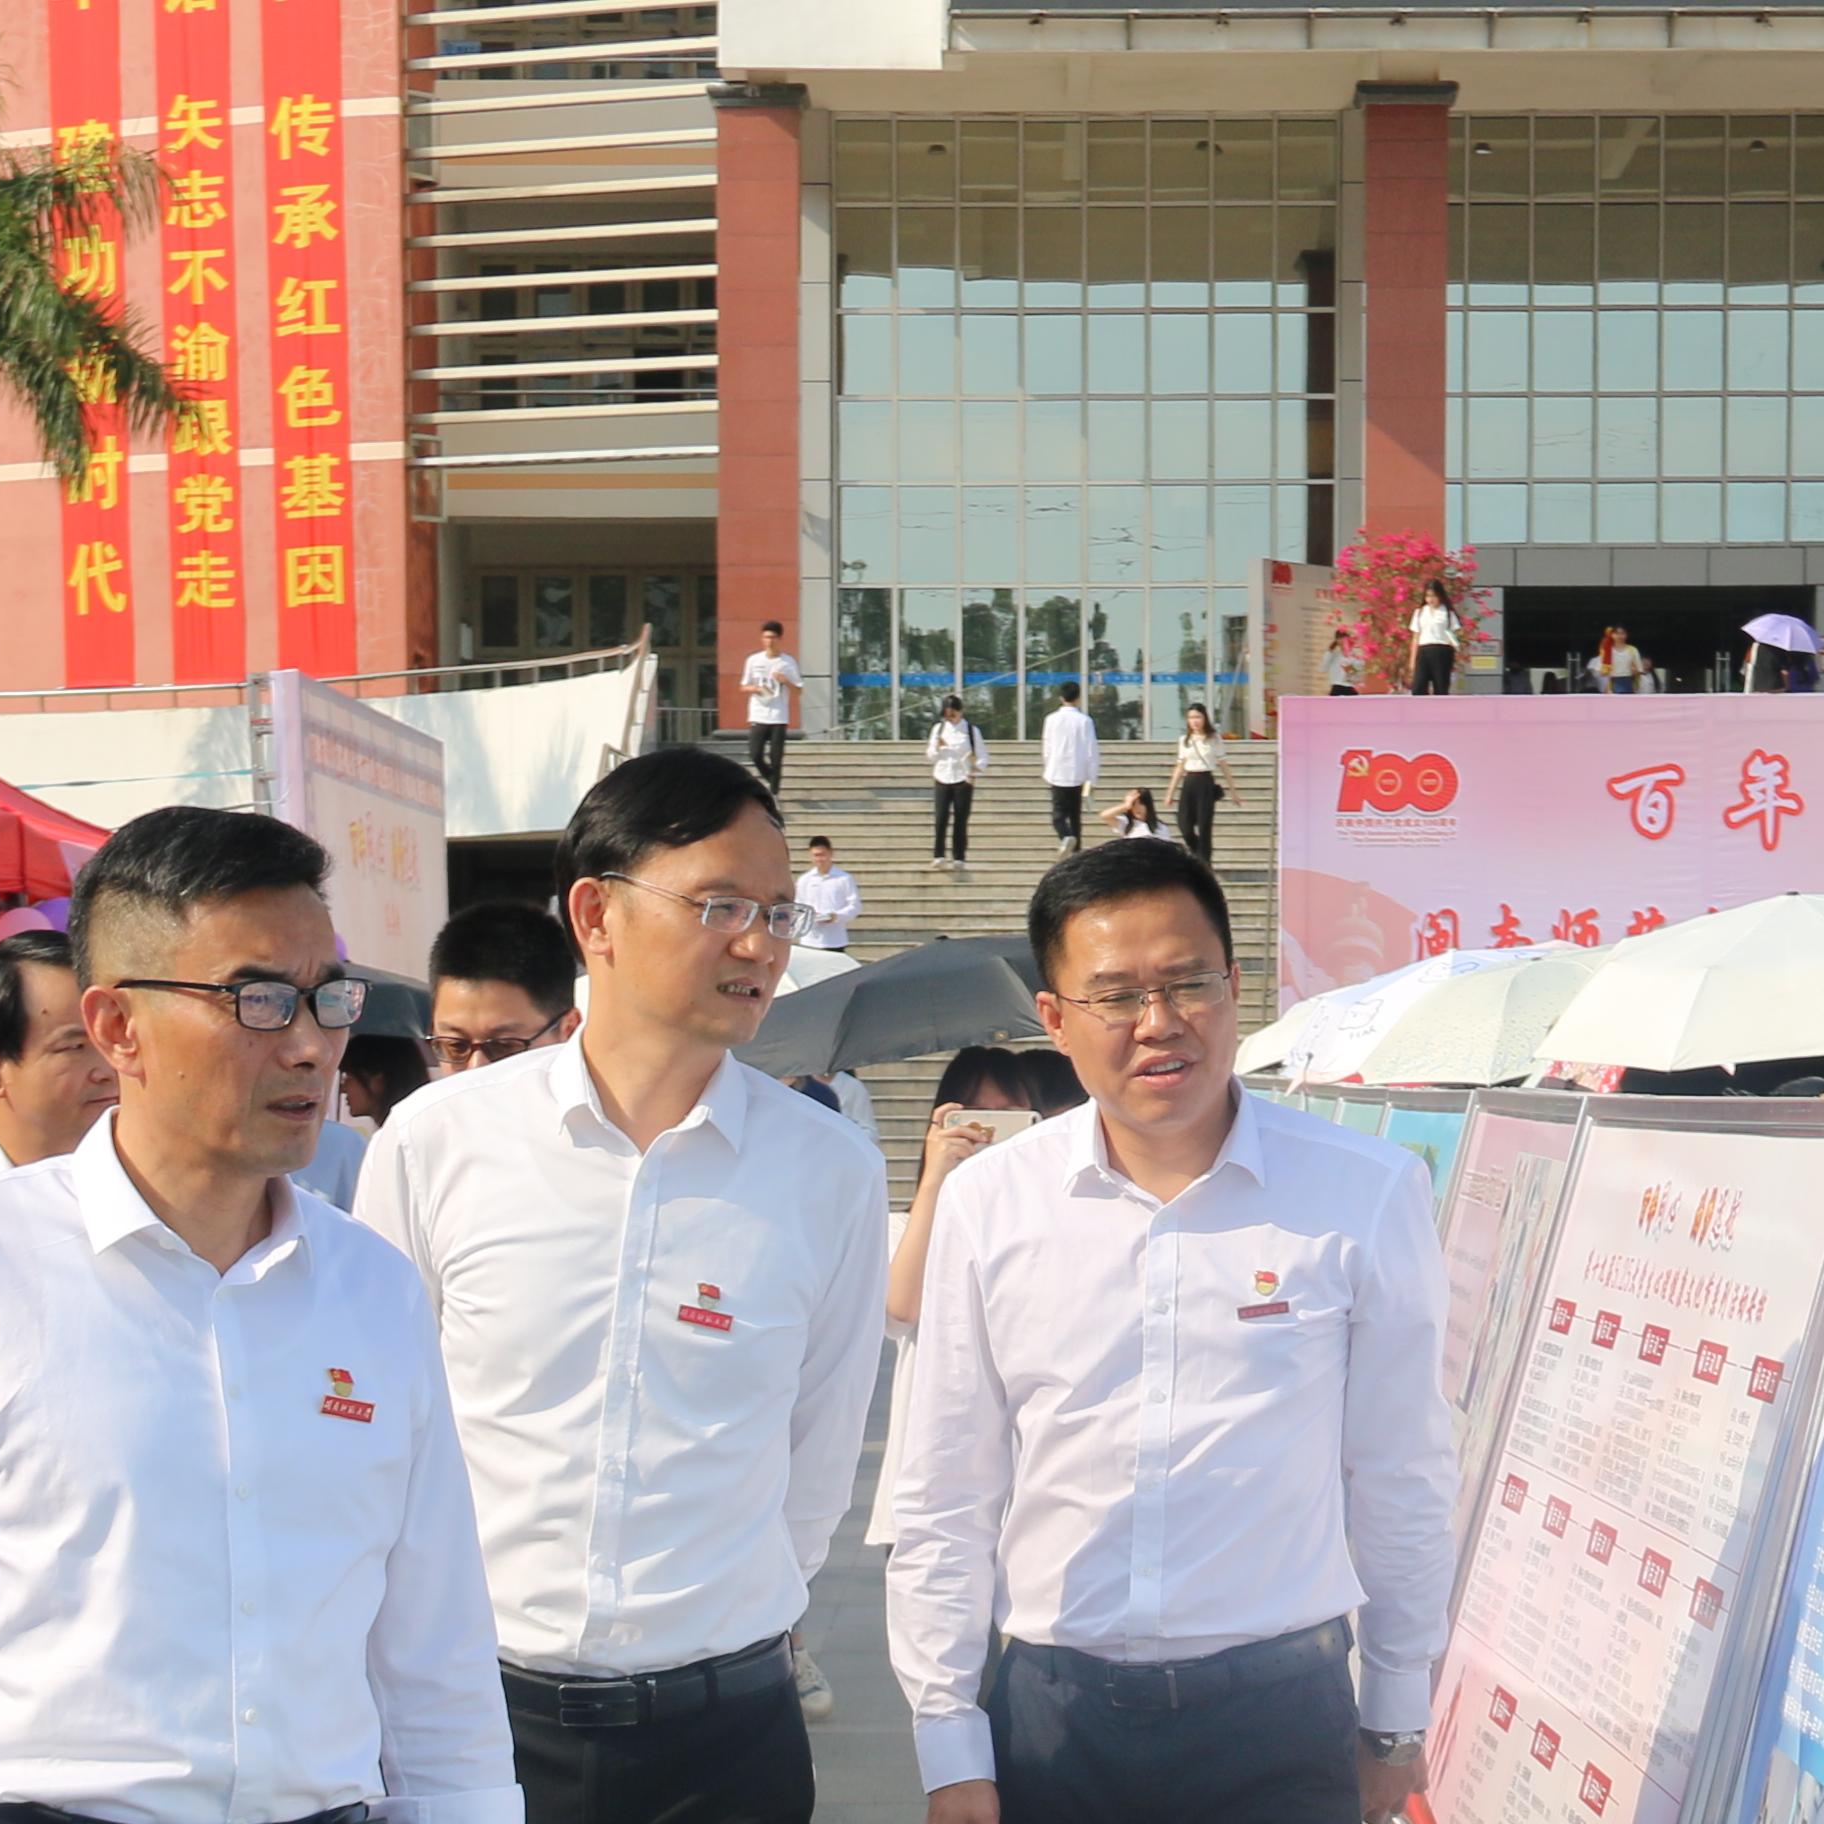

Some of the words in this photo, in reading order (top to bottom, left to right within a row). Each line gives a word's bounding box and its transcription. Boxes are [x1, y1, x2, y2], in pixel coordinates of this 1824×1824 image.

[164, 94, 236, 608] 矢志不渝跟党走
[268, 94, 346, 608] 传承红色基因
